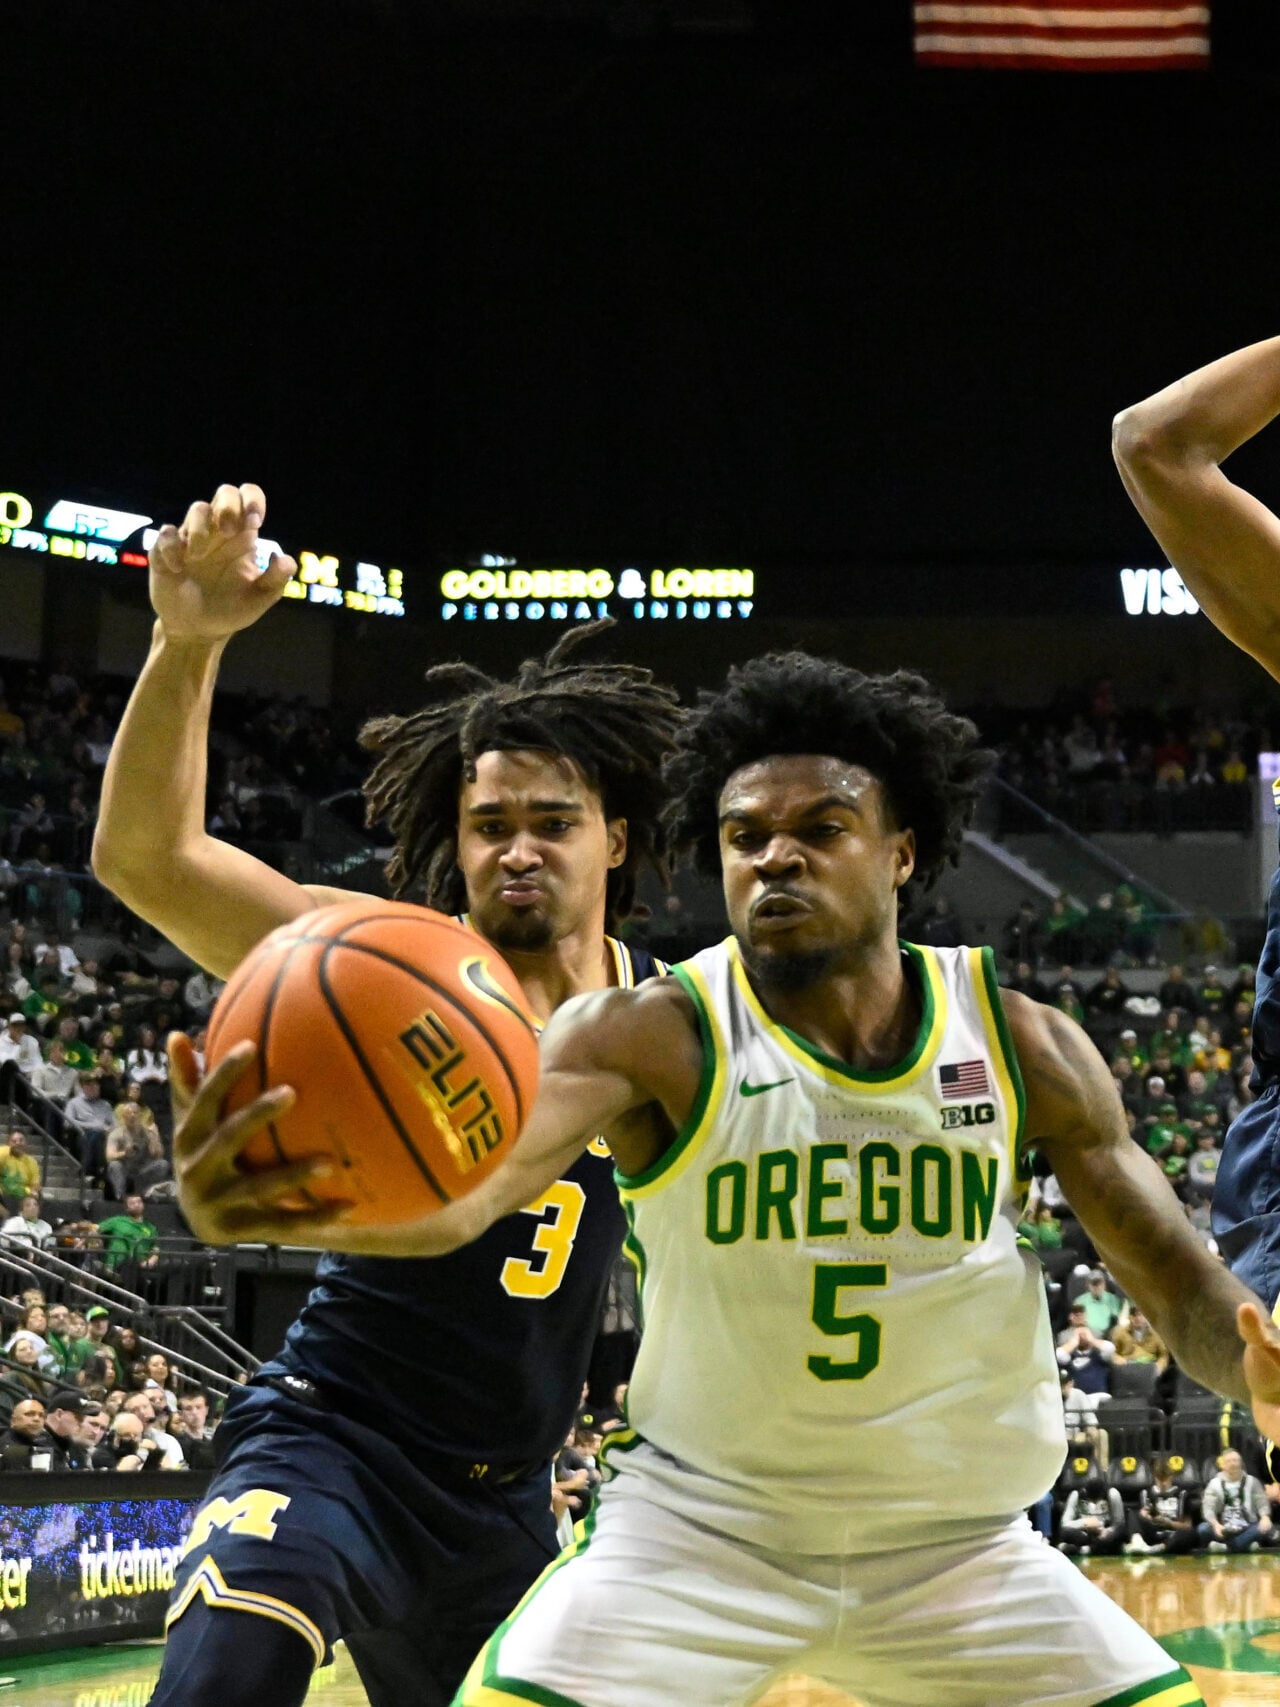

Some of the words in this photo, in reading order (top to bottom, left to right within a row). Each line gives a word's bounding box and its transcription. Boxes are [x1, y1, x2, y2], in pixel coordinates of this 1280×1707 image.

[441, 569, 614, 600] GOLDBERG
[617, 568, 646, 600] &
[651, 568, 754, 599] LOREN
[442, 601, 609, 621] PERSONAL
[633, 601, 755, 621] INJURY
[399, 1007, 505, 1166] ELITE
[500, 1179, 587, 1300] 3
[705, 1141, 999, 1245] OREGON
[807, 1263, 887, 1382] 5
[182, 1488, 291, 1556] M
